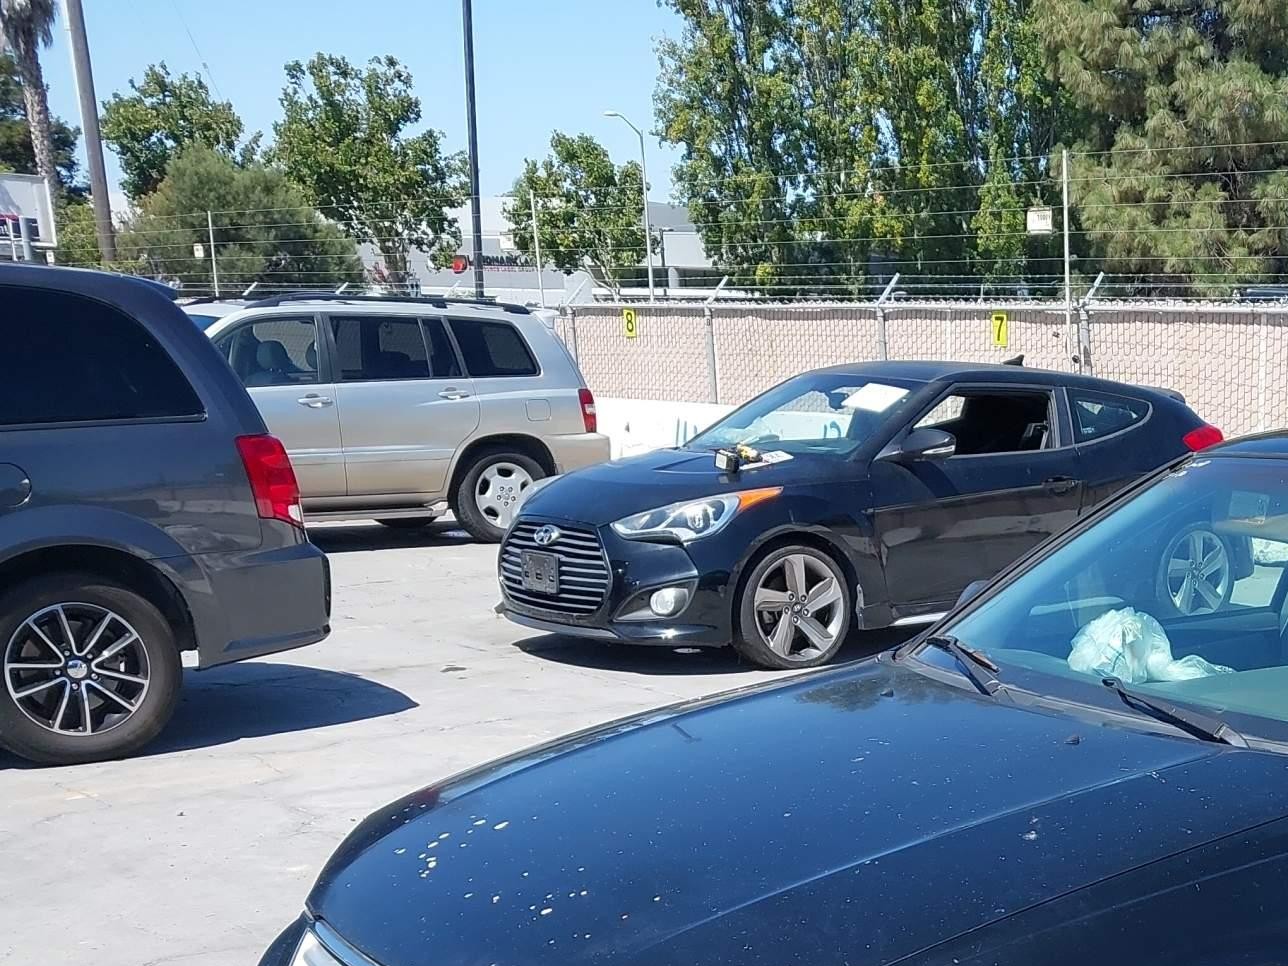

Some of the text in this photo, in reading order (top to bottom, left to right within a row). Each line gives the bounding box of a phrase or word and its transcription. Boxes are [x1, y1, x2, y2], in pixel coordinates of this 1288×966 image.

[467, 254, 518, 266] LDMARK
[626, 312, 634, 333] 8
[994, 315, 1005, 341] 7
